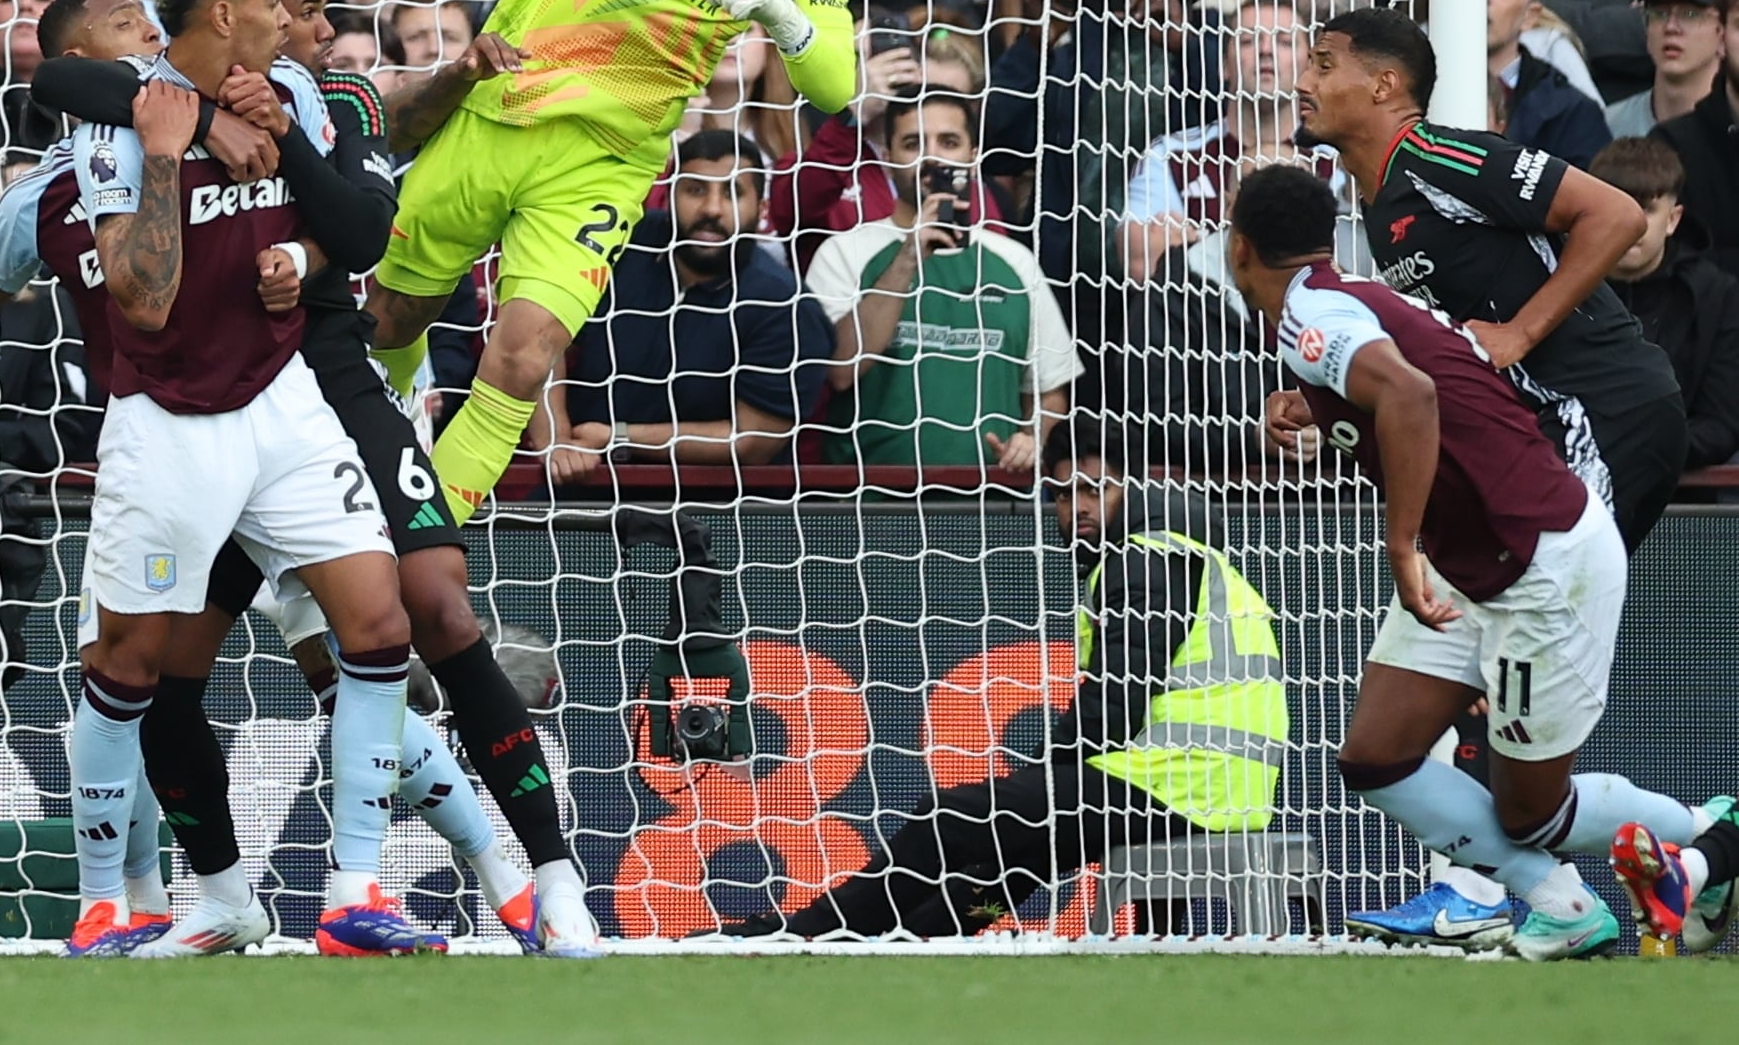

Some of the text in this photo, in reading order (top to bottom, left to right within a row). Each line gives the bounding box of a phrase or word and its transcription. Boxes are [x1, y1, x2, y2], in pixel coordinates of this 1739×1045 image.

[334, 460, 375, 514] 2
[398, 447, 435, 501] 6
[1498, 657, 1531, 717] 11
[491, 728, 534, 759] AFC
[78, 786, 125, 800] 1874
